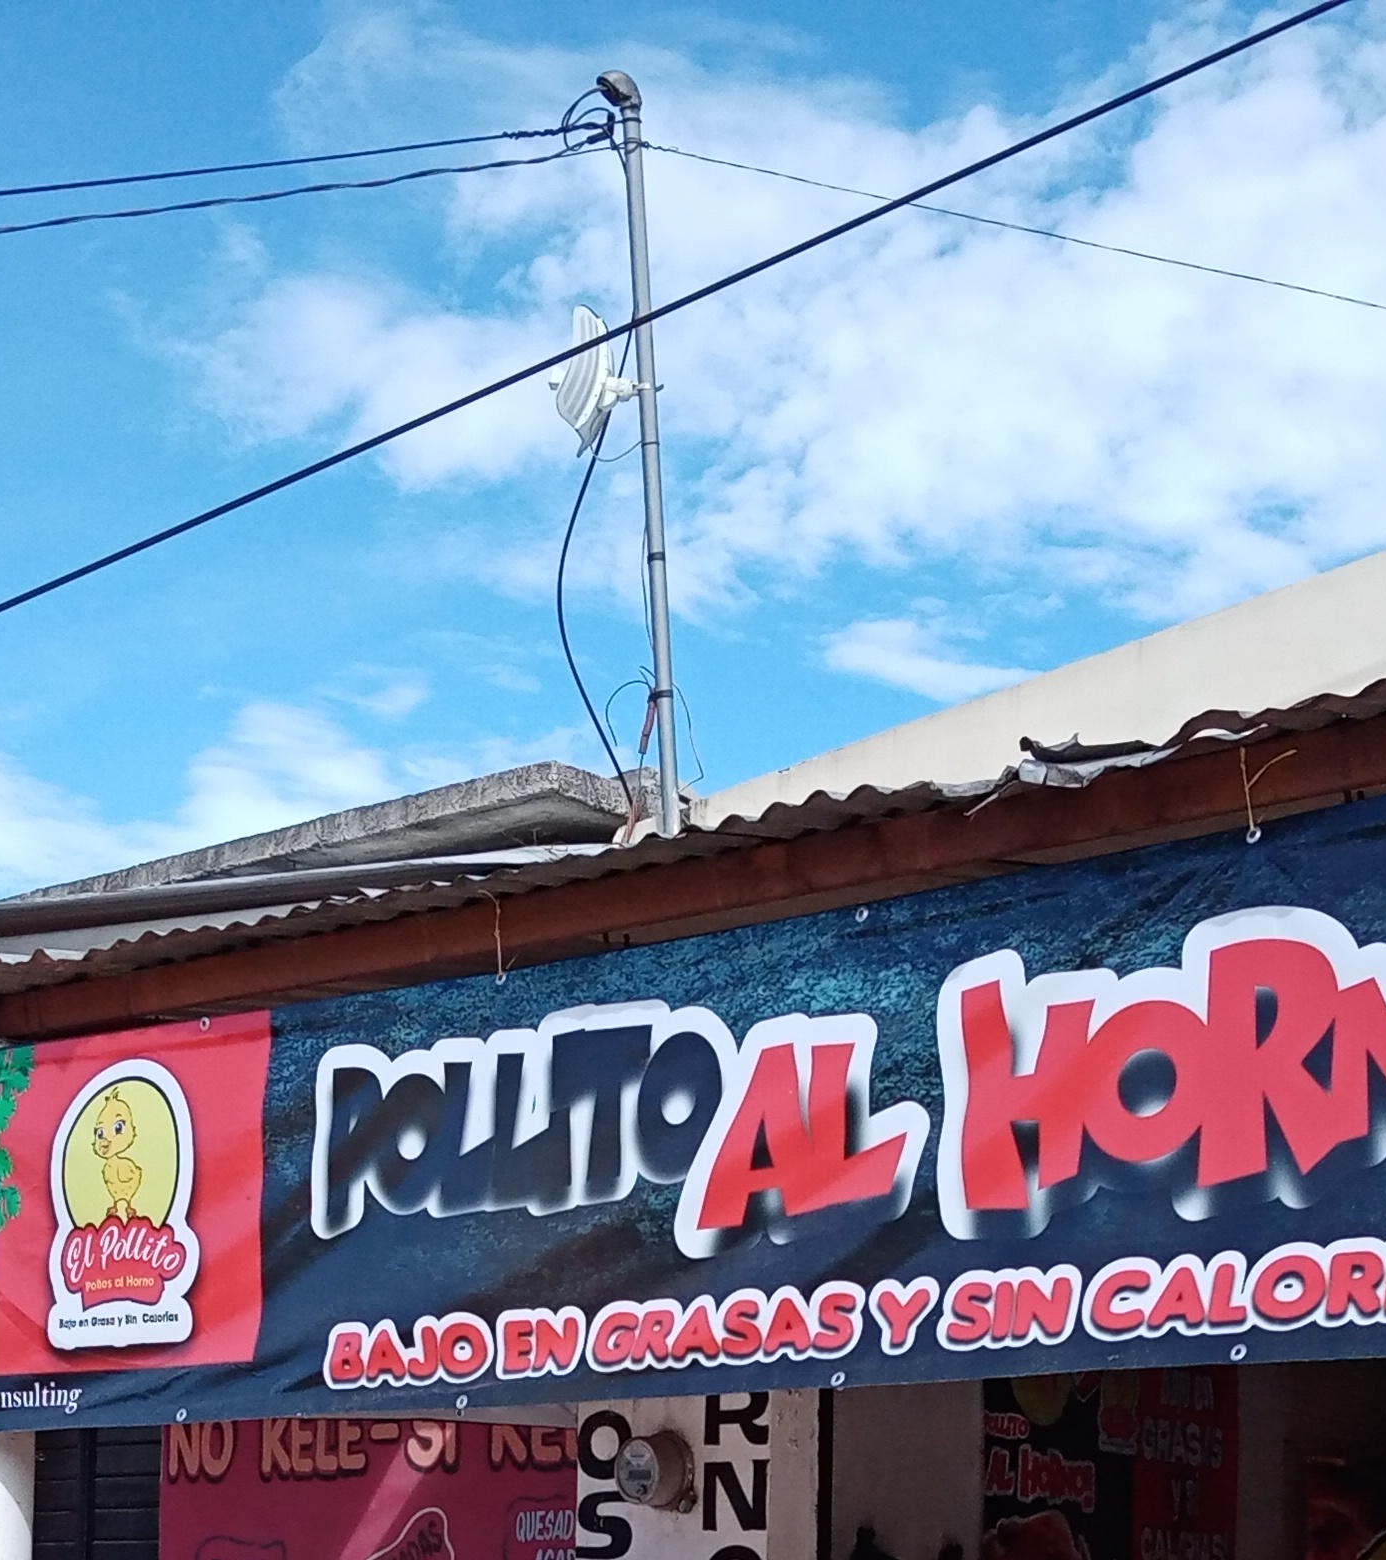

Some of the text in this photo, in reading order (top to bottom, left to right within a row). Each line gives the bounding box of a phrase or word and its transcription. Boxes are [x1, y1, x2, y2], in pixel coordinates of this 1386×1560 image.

[314, 1003, 733, 1238] POLLITO
[681, 1020, 923, 1250] AL
[66, 1225, 180, 1283] El Pollito
[126, 1275, 155, 1288] Horno
[326, 1314, 491, 1387] BAJO
[498, 1309, 583, 1376] EN
[588, 1284, 861, 1371] GRASAS
[873, 1280, 935, 1352] Y
[942, 1267, 1079, 1348] SIN
[167, 1419, 235, 1480] NO
[515, 1509, 575, 1543] QUESAD
